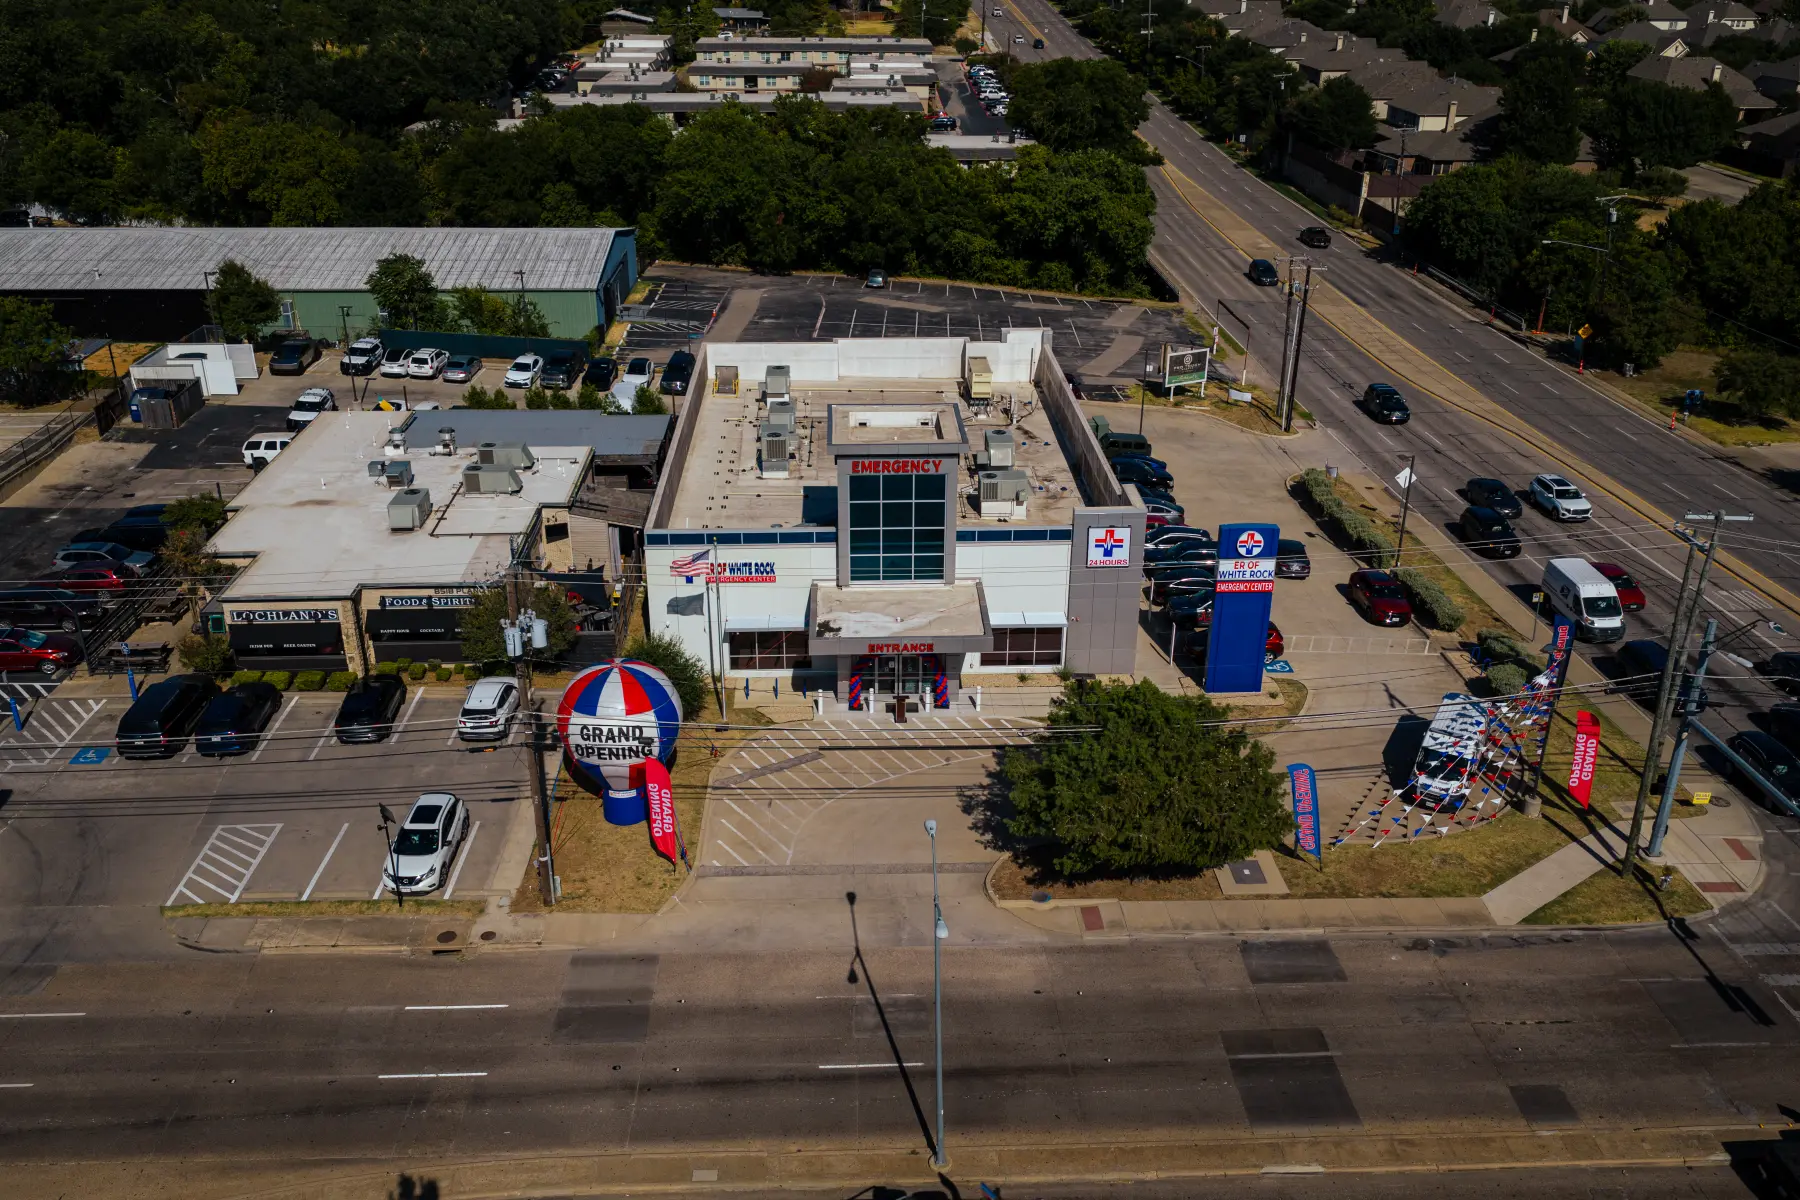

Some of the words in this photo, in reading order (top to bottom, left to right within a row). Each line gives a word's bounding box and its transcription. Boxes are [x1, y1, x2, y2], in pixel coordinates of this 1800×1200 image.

[851, 460, 943, 473] EMERGENCY
[728, 562, 752, 575] WHITE
[754, 562, 776, 575] ROCK
[1234, 561, 1245, 569] ER
[1247, 561, 1260, 569] OF
[1218, 570, 1247, 579] WHITE
[1249, 570, 1275, 578] ROCK
[1216, 583, 1251, 591] EMERGENCY
[1251, 582, 1273, 590] CENTER
[385, 598, 419, 606] FOOD
[431, 597, 475, 605] SPIRITS
[232, 610, 337, 621] LOCHLAND'S
[868, 643, 934, 653] ENTRANCE
[580, 725, 643, 743] GRAND
[574, 744, 653, 760] OPENING
